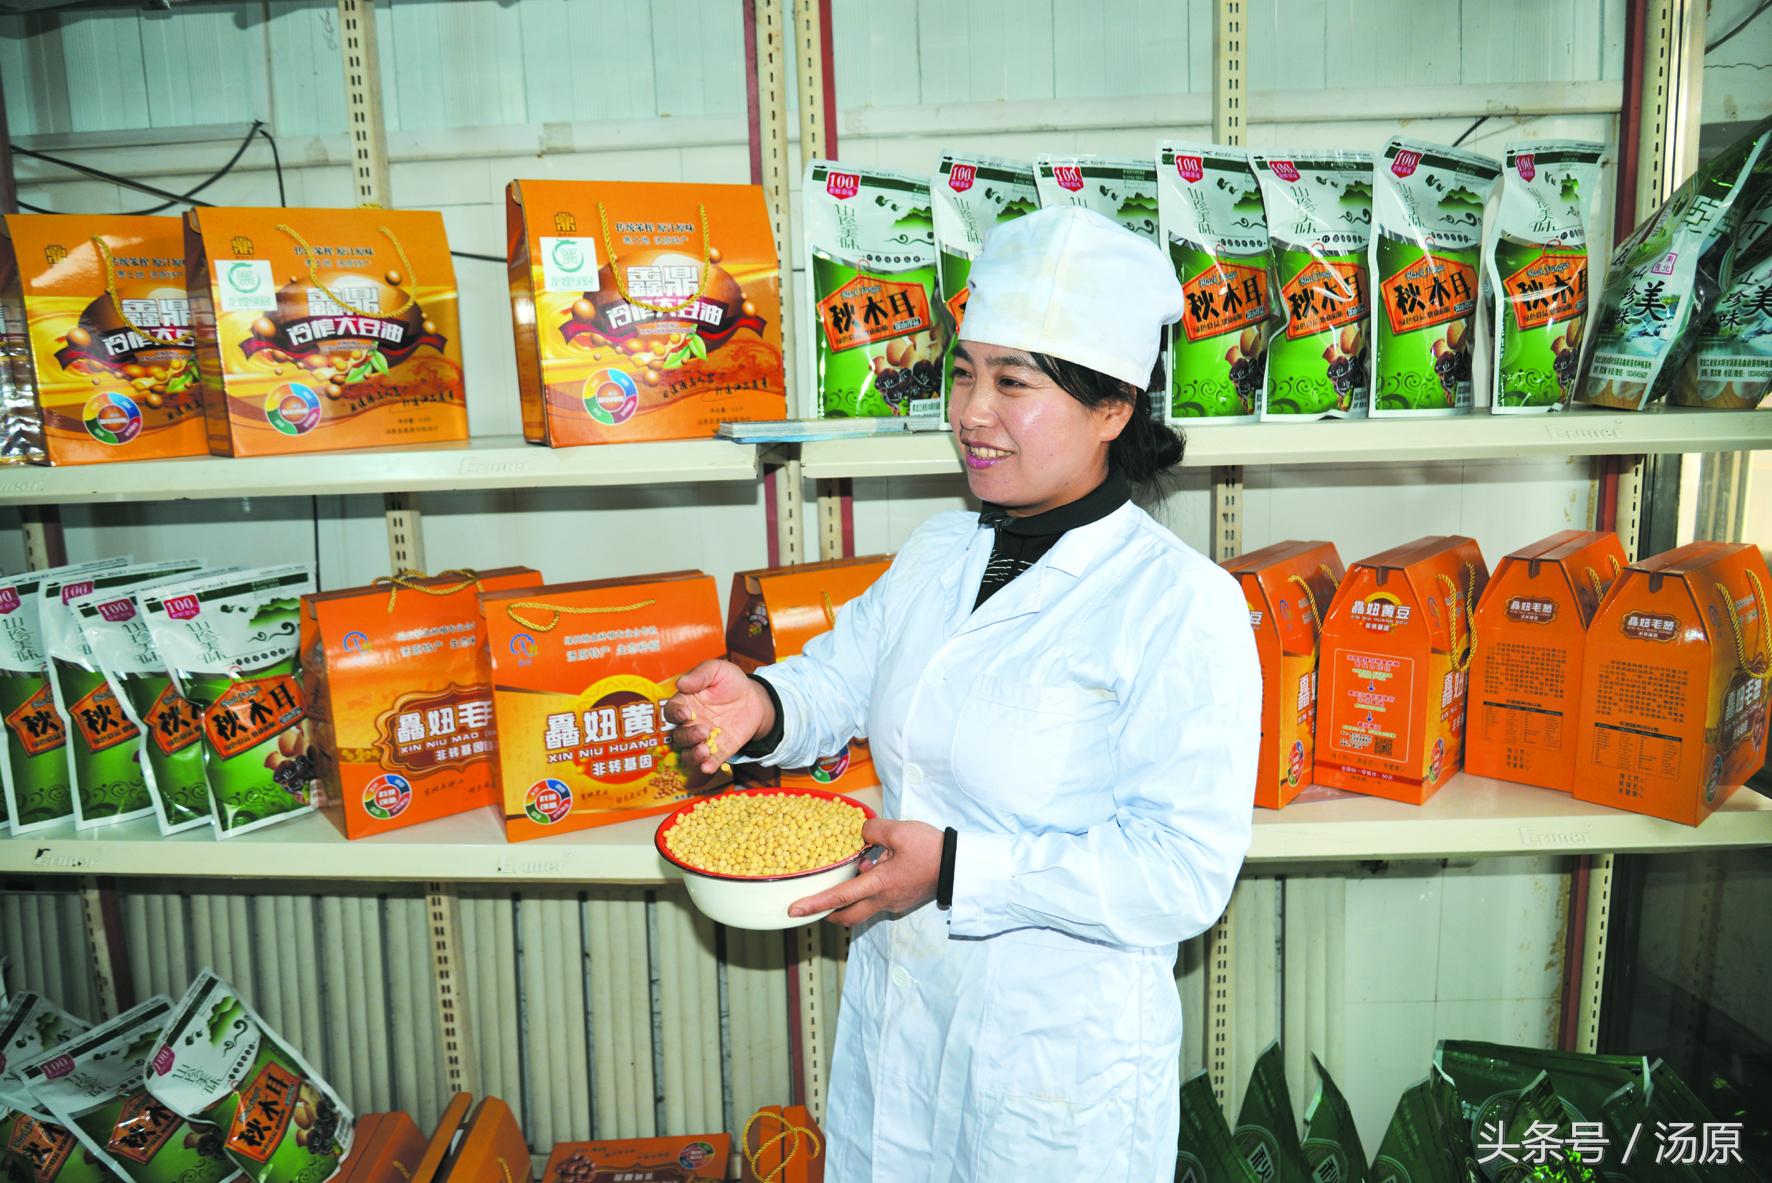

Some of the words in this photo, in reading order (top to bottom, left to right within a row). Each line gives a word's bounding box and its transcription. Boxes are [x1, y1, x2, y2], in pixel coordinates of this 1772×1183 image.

[829, 288, 917, 334] 秋木耳
[1186, 275, 1263, 323] 秋木耳
[1394, 270, 1471, 316] 秋木耳
[1633, 279, 1667, 322] 美
[286, 316, 405, 346] 冷榨大豆油
[212, 681, 297, 742] 秋木耳
[400, 743, 422, 754] XIN
[426, 739, 447, 749] NIU
[451, 731, 479, 743] MAO
[548, 751, 573, 763] XIN
[579, 747, 604, 759] NIU
[609, 738, 658, 754] HUANG
[591, 753, 653, 777] 非转基因
[237, 1073, 290, 1148] 秋木耳
